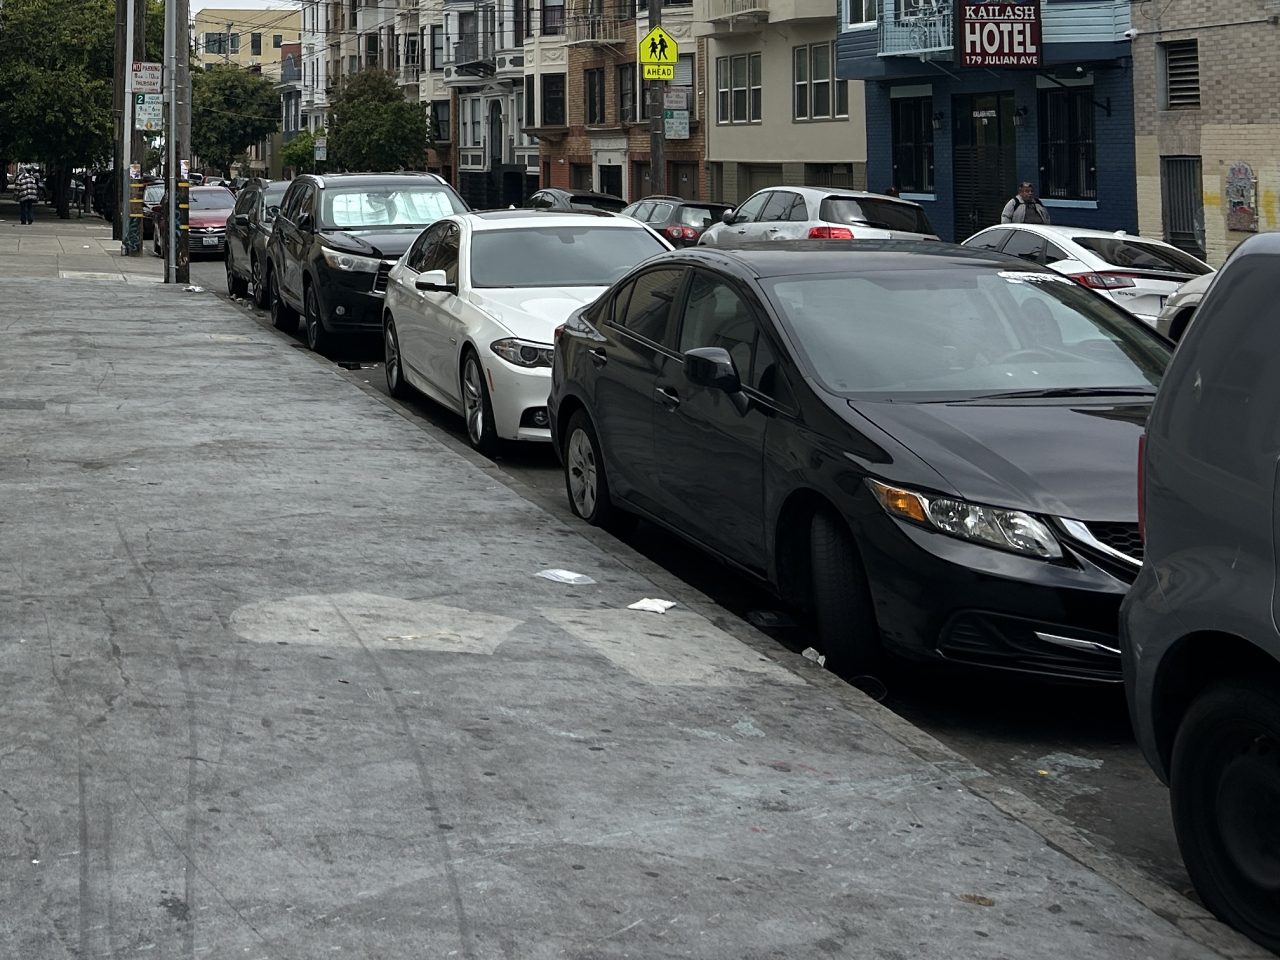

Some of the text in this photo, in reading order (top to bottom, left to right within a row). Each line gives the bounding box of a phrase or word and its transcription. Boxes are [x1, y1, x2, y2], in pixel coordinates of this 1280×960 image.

[965, 6, 1035, 19] KAILASH
[965, 23, 1037, 54] HOTEL
[966, 56, 1038, 65] 179 JULIAN AVE
[132, 63, 160, 72] NO PARKING
[647, 68, 672, 76] AHEAD
